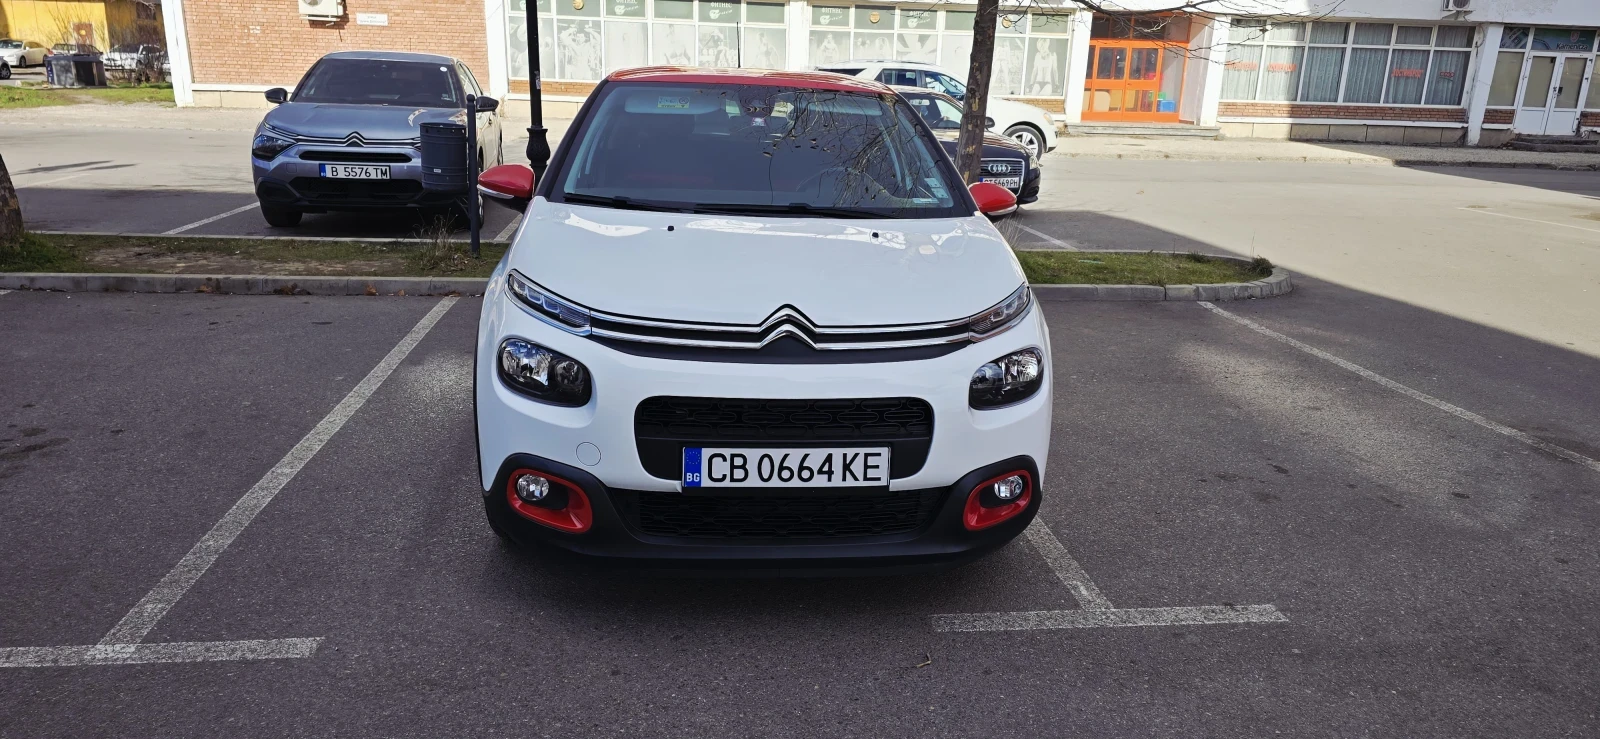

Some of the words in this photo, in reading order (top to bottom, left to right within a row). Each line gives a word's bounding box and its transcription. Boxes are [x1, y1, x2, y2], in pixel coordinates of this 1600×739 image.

[1556, 42, 1589, 51] Kamenitza
[331, 166, 339, 177] B
[344, 167, 371, 178] 5576
[373, 167, 388, 178] TM
[707, 452, 749, 483] CB
[757, 452, 835, 483] 0664
[841, 452, 882, 482] KE
[686, 472, 701, 482] BG
